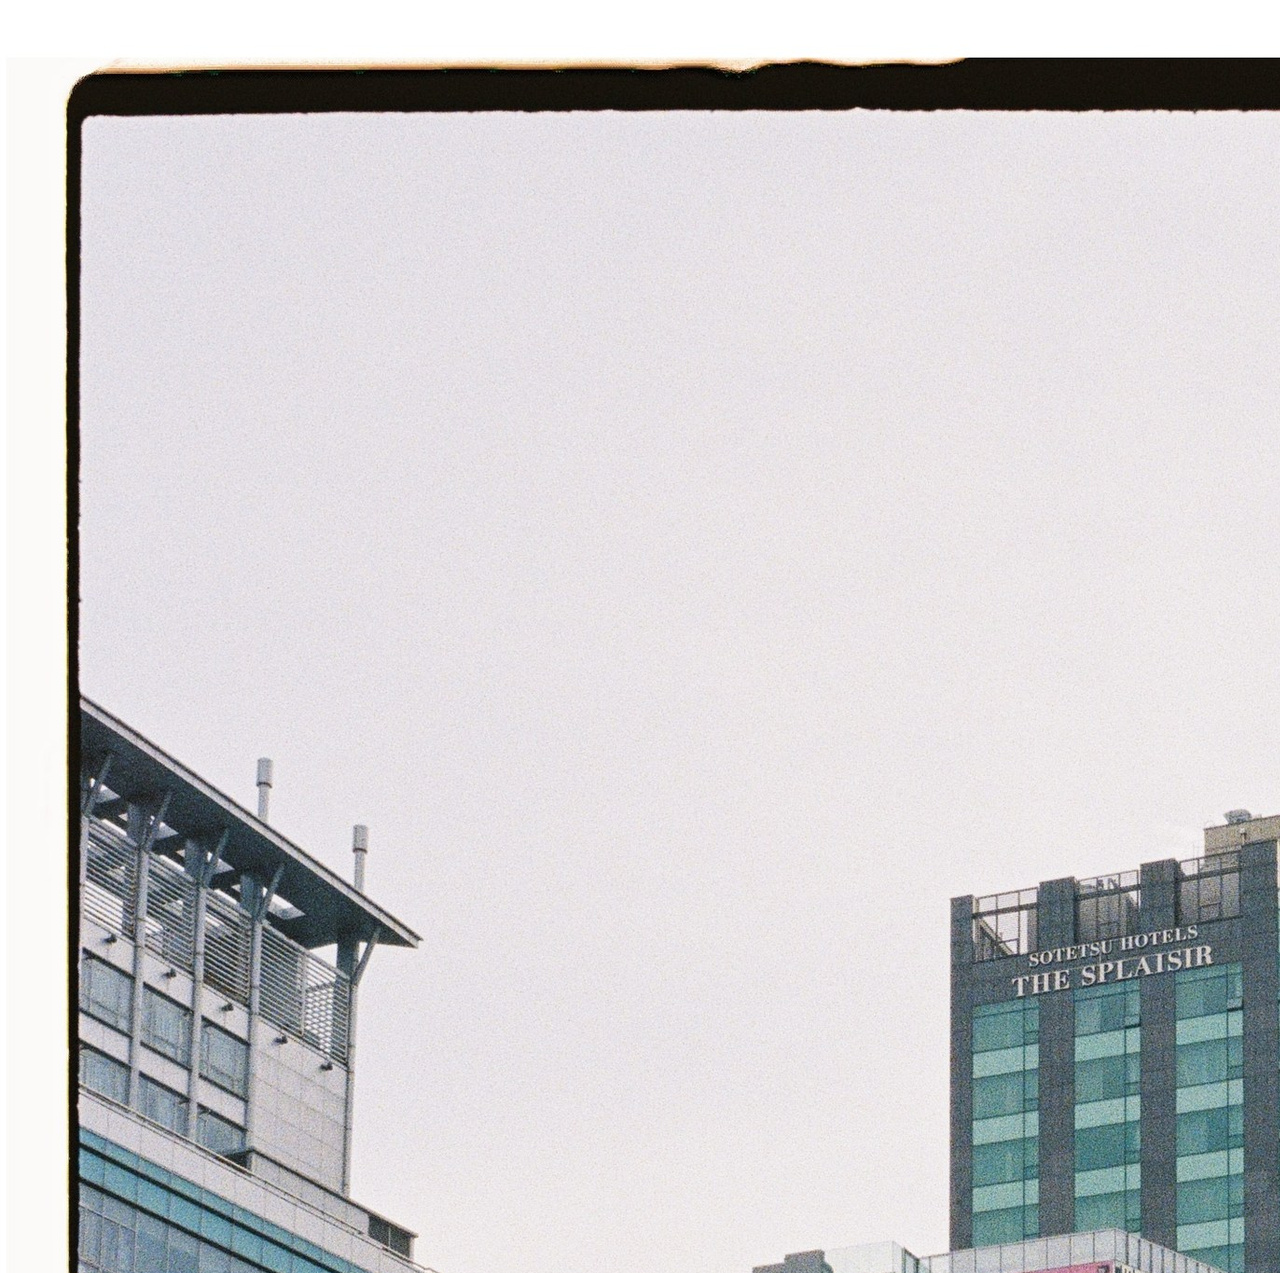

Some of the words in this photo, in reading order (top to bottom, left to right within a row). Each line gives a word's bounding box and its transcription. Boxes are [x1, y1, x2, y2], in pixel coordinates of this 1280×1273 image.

[1028, 940, 1114, 967] SOTETSU
[1121, 925, 1199, 951] HOTELS
[1011, 969, 1071, 998] THE
[1080, 945, 1214, 987] SPLAISIR
